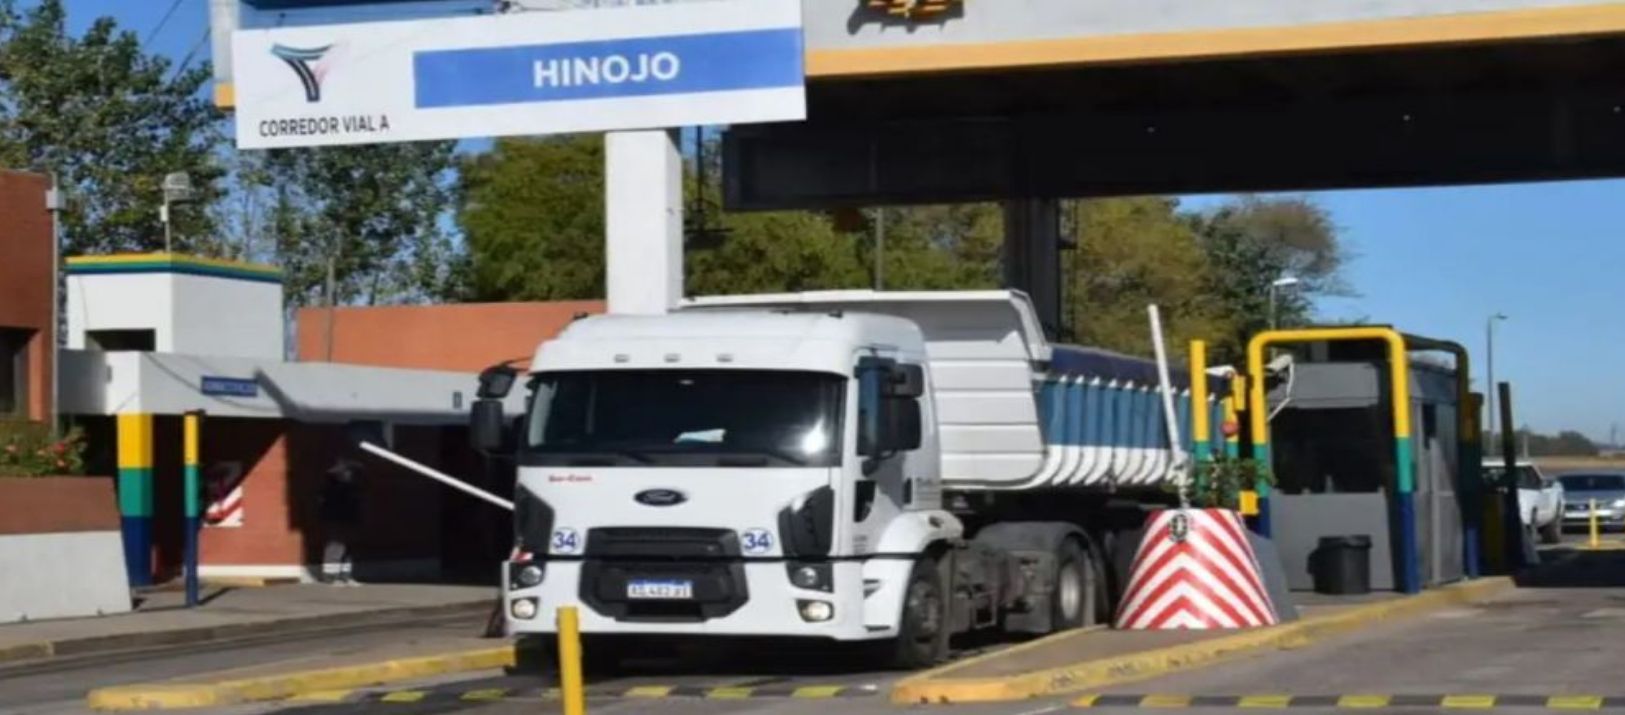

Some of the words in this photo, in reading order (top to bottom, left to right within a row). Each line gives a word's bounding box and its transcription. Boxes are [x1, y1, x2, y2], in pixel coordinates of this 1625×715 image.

[533, 51, 680, 87] HINOJO
[259, 117, 339, 137] CORREDOR
[343, 115, 376, 133] VIAL
[379, 114, 390, 132] A
[553, 531, 577, 548] 34
[744, 532, 770, 550] 34
